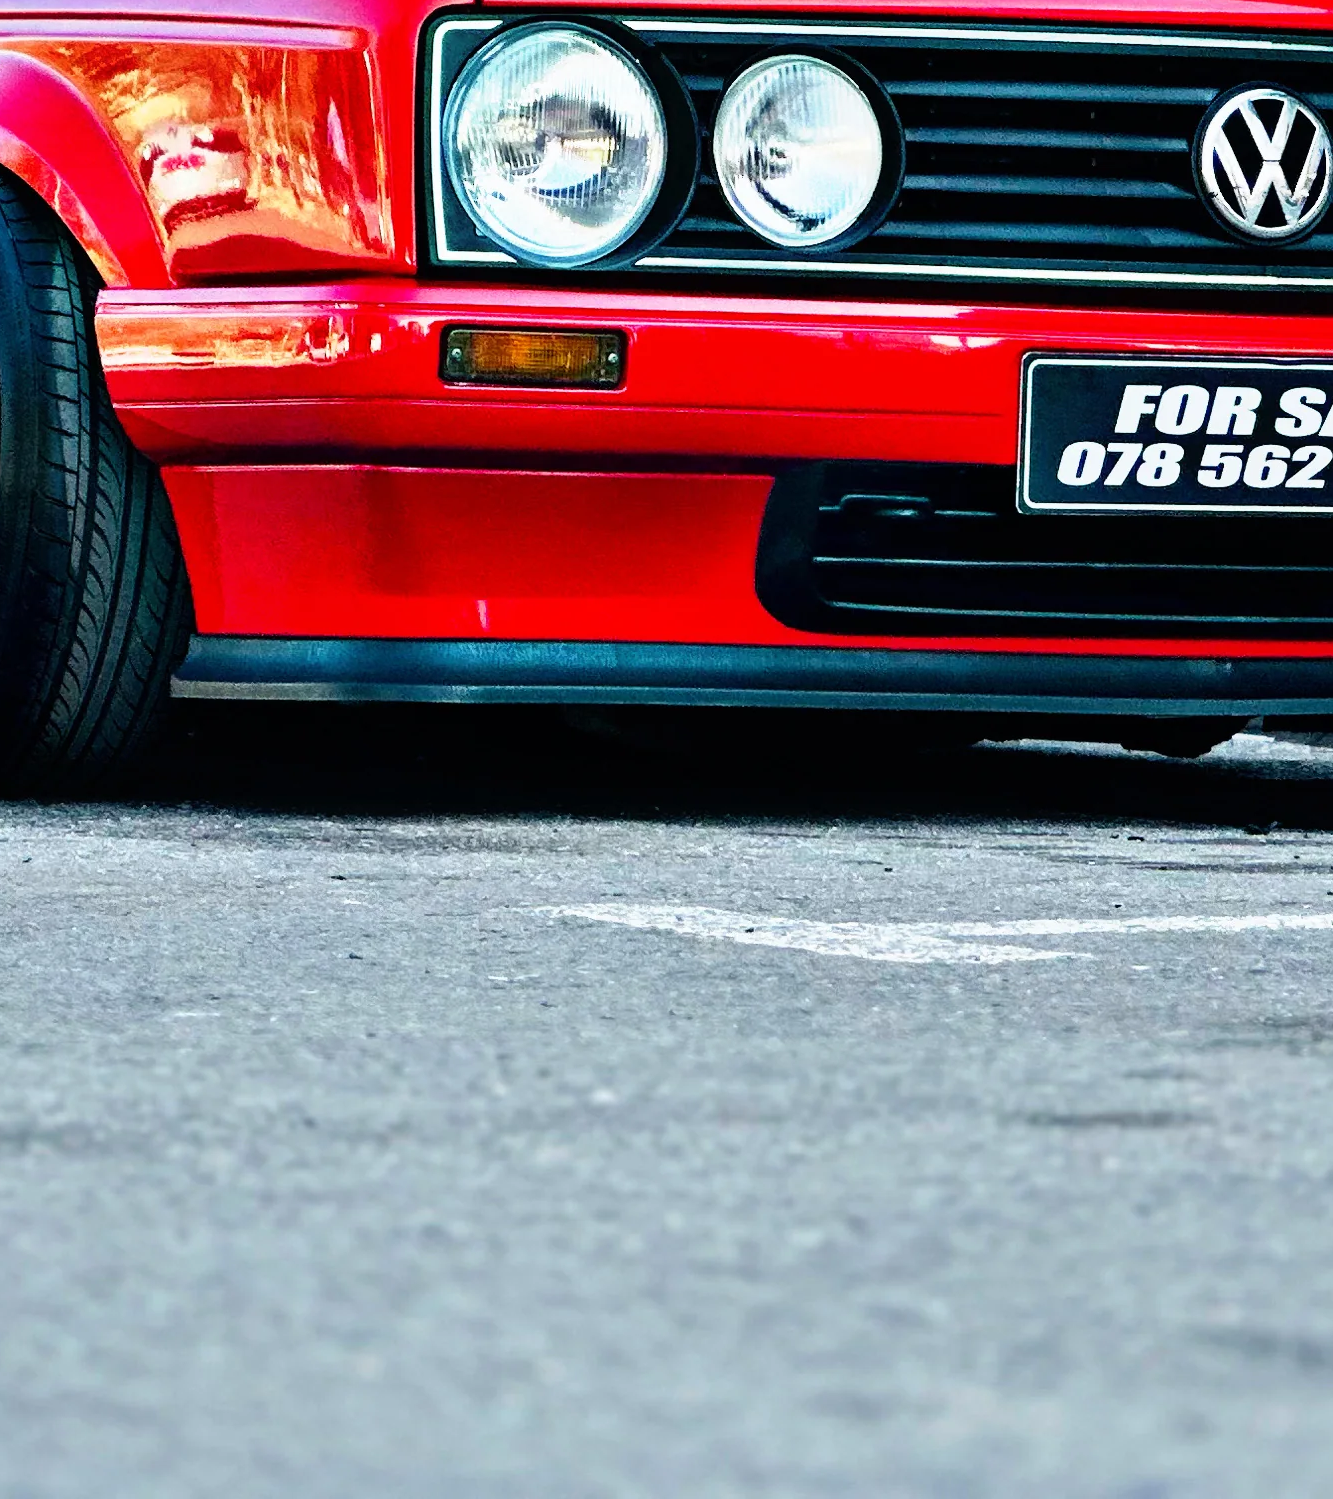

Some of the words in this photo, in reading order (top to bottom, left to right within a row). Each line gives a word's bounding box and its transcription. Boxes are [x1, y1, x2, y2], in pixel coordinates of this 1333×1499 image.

[1202, 88, 1330, 238] VW
[1114, 384, 1263, 436] FOR
[1056, 441, 1185, 488] 078
[1197, 444, 1333, 490] 562
